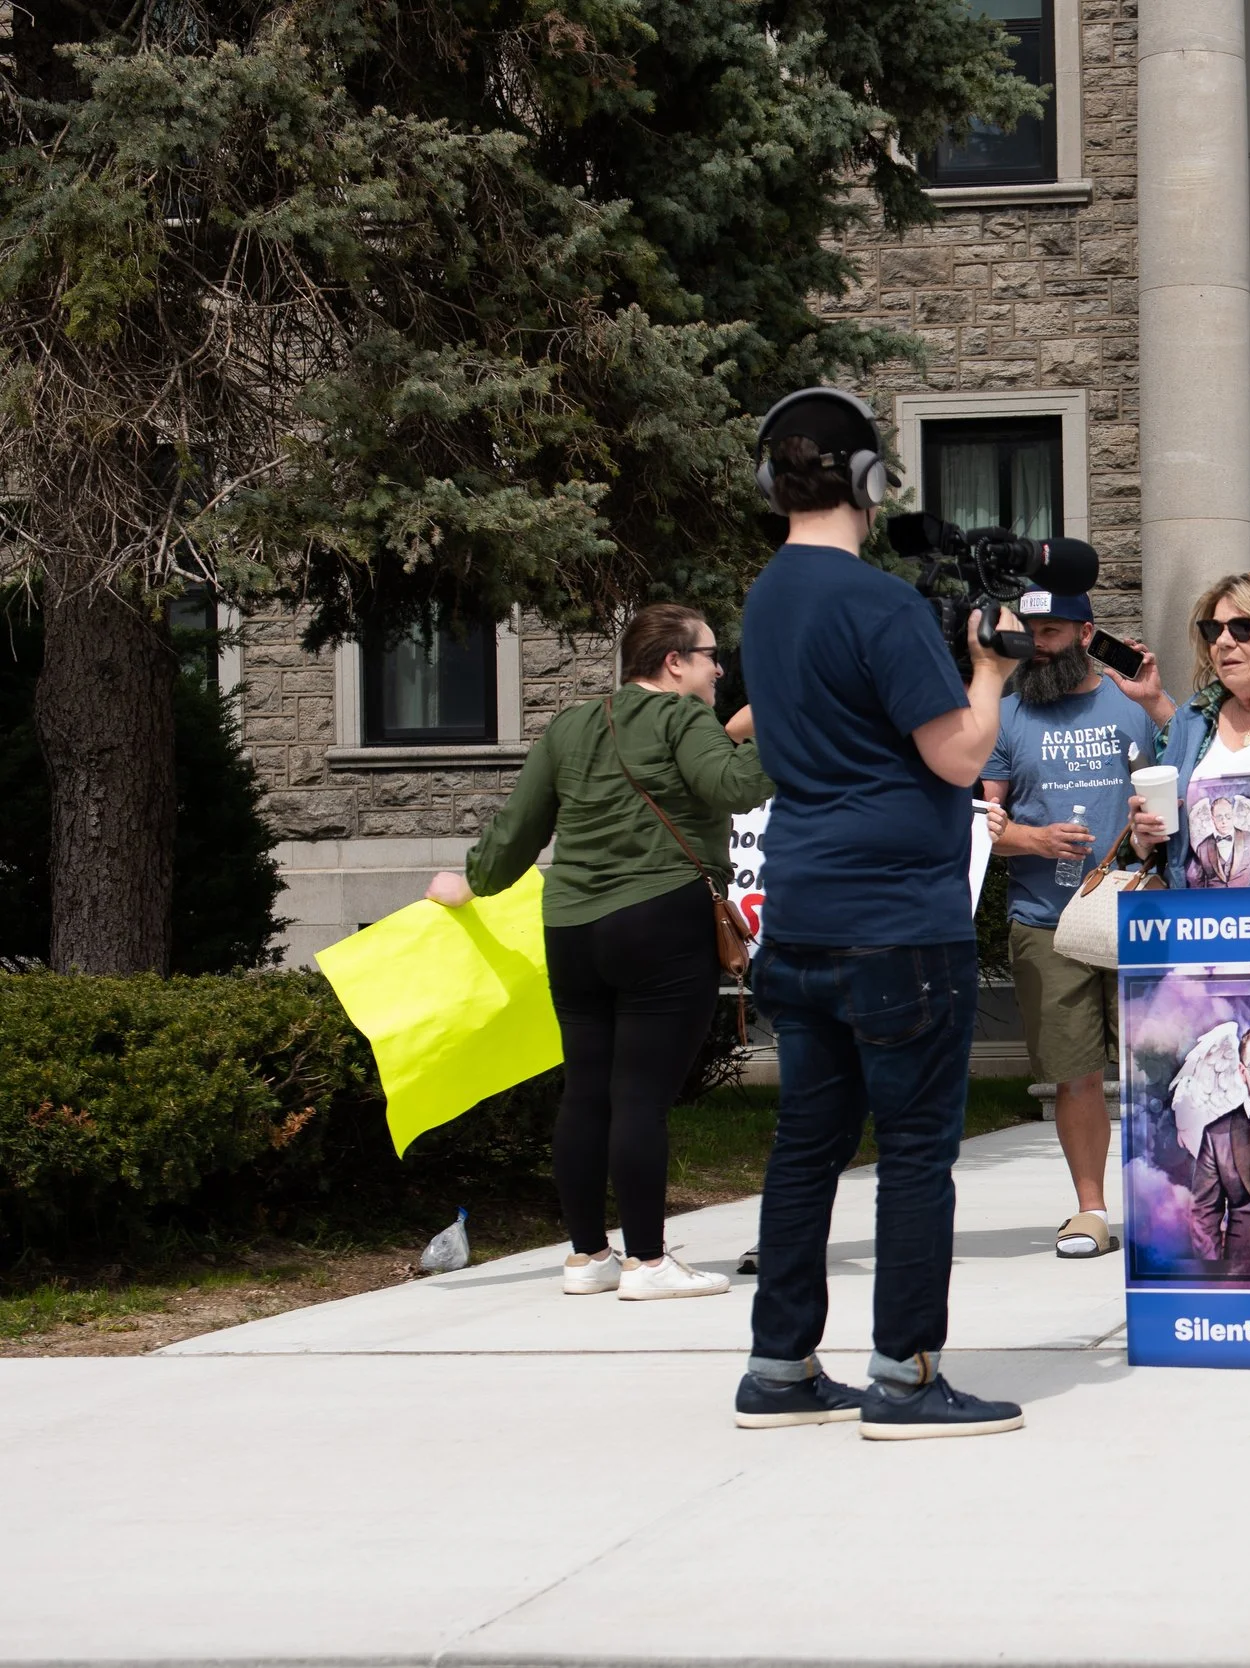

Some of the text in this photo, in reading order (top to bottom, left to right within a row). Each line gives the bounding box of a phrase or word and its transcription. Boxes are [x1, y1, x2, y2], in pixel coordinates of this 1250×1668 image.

[1030, 597, 1048, 607] RIDGE
[1042, 724, 1117, 744] ACADEMY
[1041, 740, 1121, 760] IVY RIDGE
[1128, 918, 1171, 942] IVY
